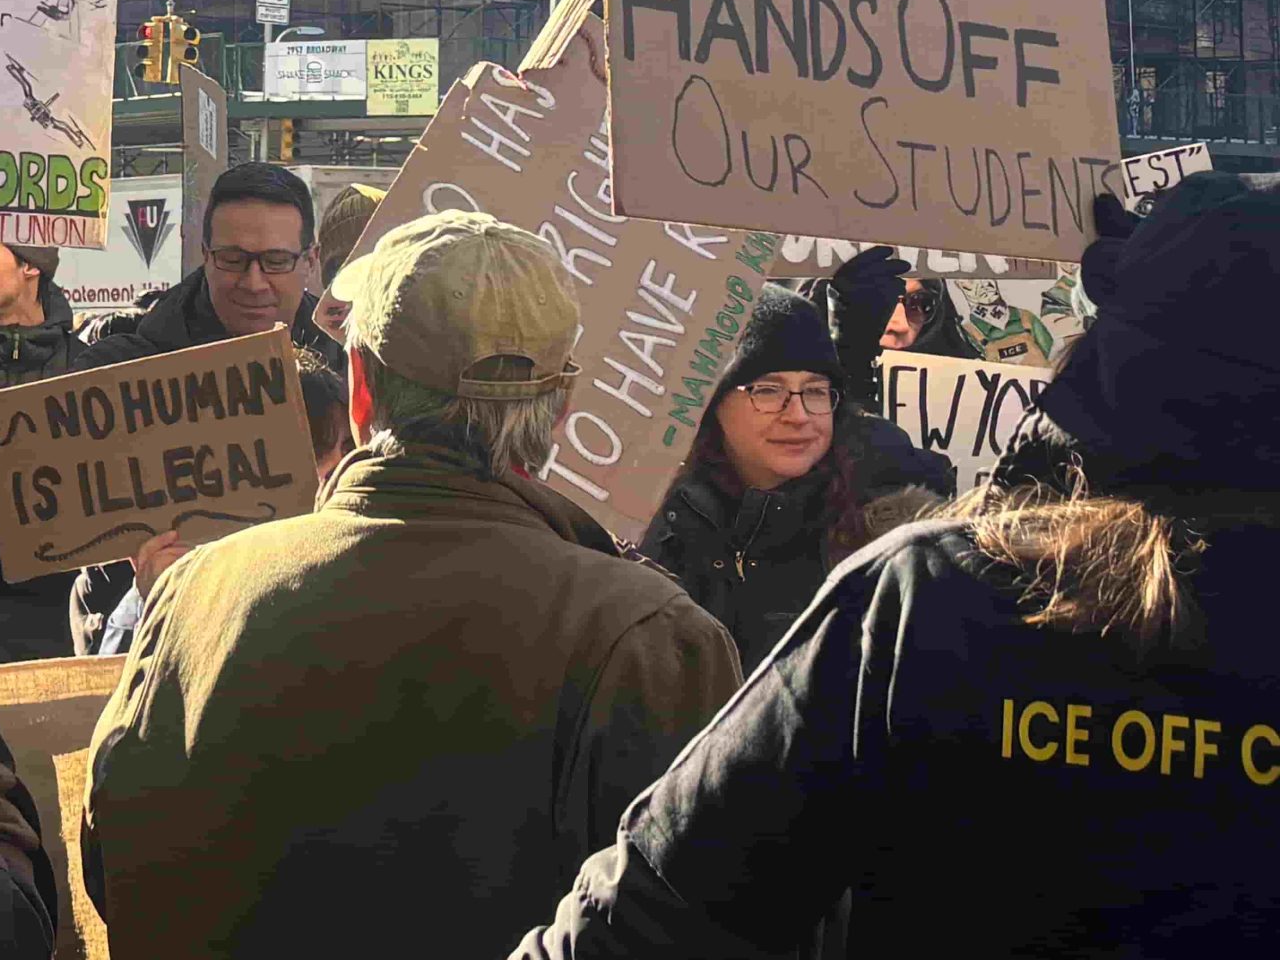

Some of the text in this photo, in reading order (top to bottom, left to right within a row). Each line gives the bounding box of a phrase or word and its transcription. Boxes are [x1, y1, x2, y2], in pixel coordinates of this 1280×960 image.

[306, 45, 347, 54] BROADWAY
[374, 63, 433, 80] KINGS
[461, 66, 557, 172] HAS
[673, 75, 828, 198] OUR
[14, 213, 87, 245] UNION
[45, 357, 287, 439] NO HUMAN
[538, 411, 623, 502] TO
[592, 259, 697, 418] HAVE
[11, 438, 293, 525] IS ILLEGAL
[1001, 699, 1092, 766] ICE
[1111, 710, 1222, 779] OFF
